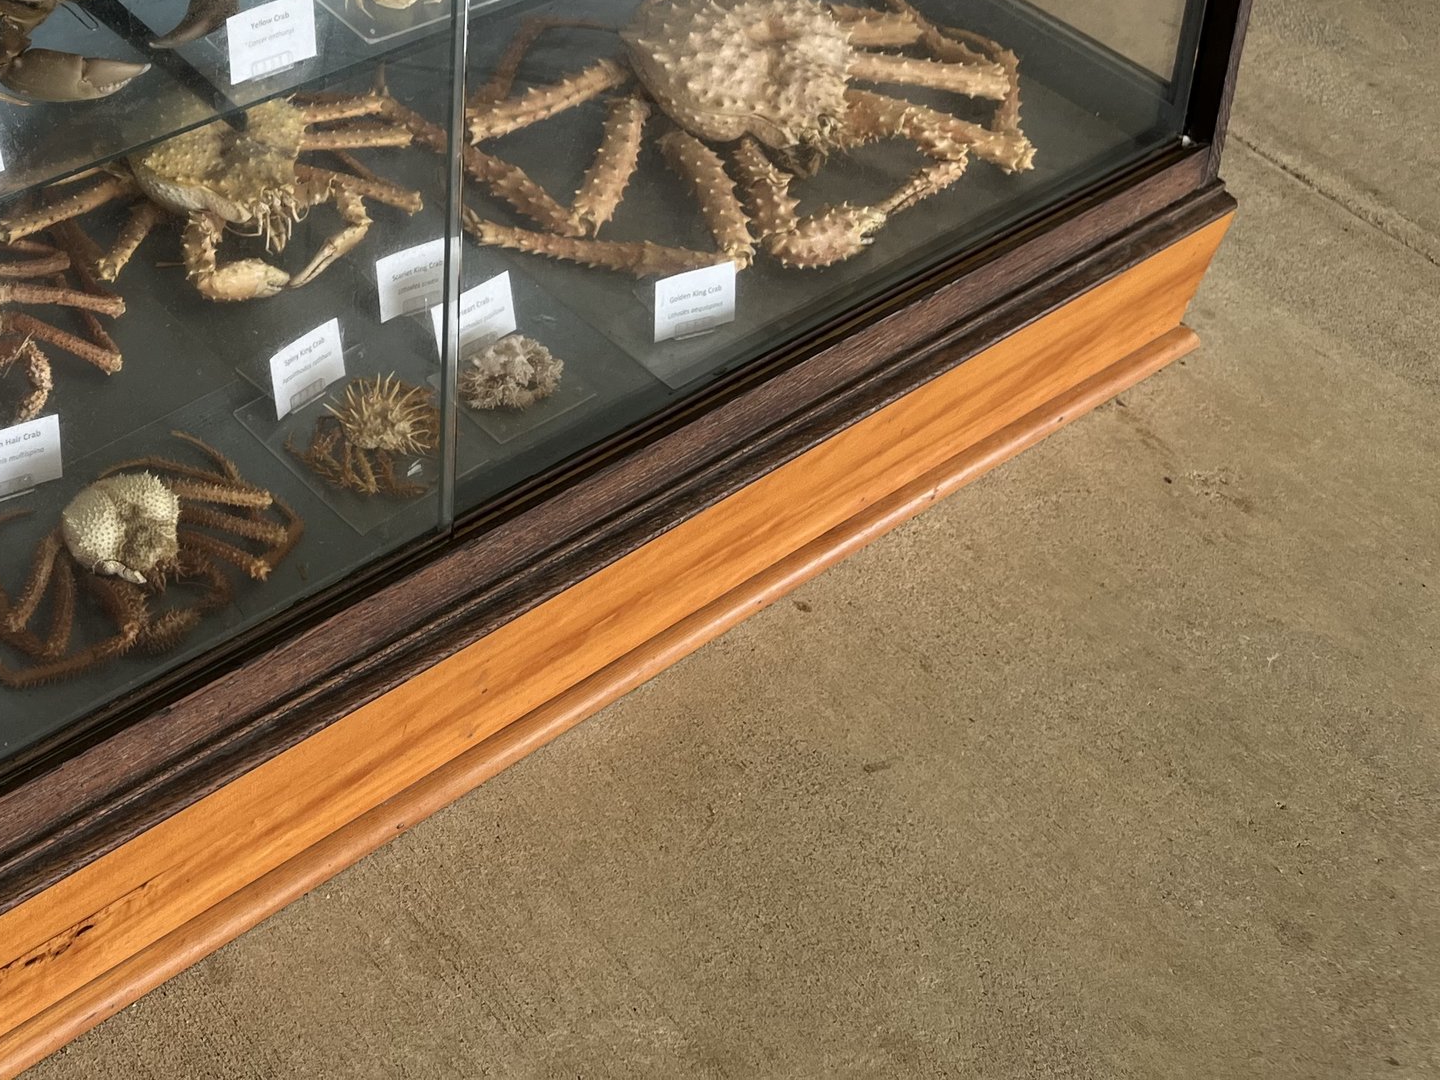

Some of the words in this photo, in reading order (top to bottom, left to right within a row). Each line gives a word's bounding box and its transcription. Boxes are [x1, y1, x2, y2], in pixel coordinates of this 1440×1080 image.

[251, 17, 273, 30] Yellow
[273, 11, 290, 23] Crab
[707, 284, 723, 294] Crab
[477, 297, 491, 308] Crab
[312, 337, 326, 349] Crab
[5, 435, 21, 447] Hair
[23, 429, 42, 442] Crab
